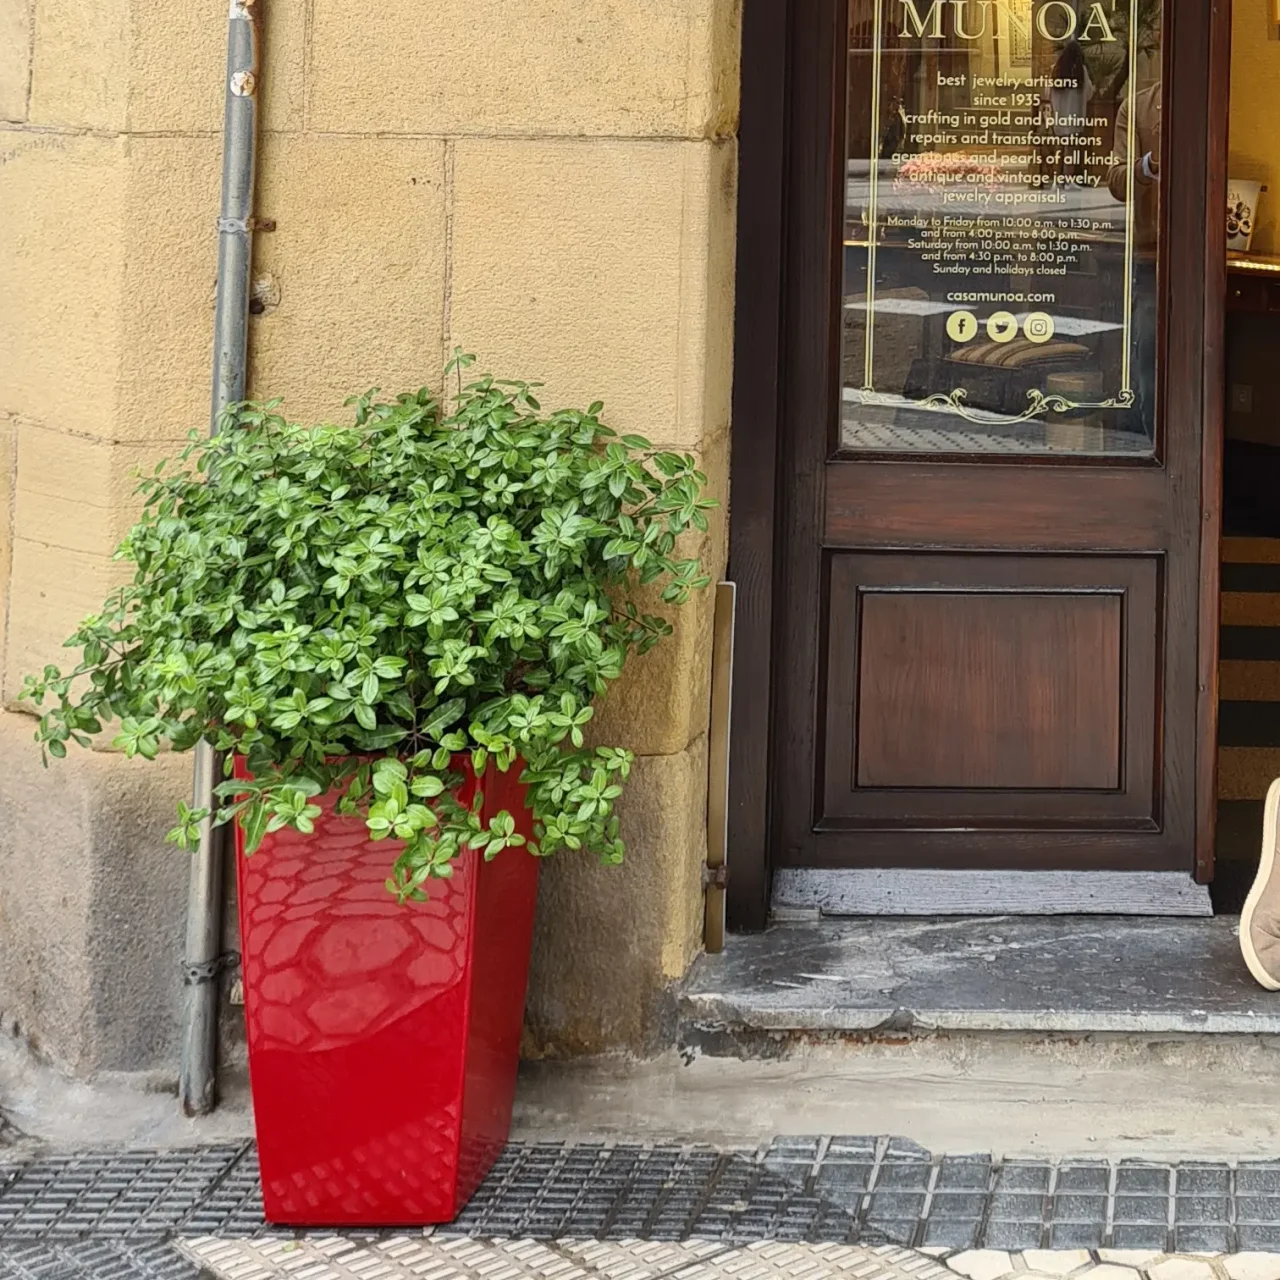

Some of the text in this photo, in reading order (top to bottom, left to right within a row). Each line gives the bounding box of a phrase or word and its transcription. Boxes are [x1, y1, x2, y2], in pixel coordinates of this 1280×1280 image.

[937, 71, 1078, 90] best jewelry artisans
[973, 93, 1040, 107] since 1935
[905, 111, 1108, 129] crafting in gold and platinum
[910, 131, 1102, 147] repairs and transformations
[969, 150, 997, 163] and
[1001, 150, 1042, 165] pearls
[1046, 150, 1060, 164] of
[1064, 151, 1080, 165] all
[1083, 151, 1120, 165] kinds
[910, 169, 1101, 187] antique and vintage jewelry
[942, 189, 1066, 204] jewelry appraisals
[887, 217, 929, 228] Monday
[931, 217, 941, 225] to
[944, 216, 974, 228] Friday
[976, 217, 1000, 226] from
[1003, 218, 1031, 227] 10:00
[1058, 219, 1068, 228] to
[1070, 219, 1090, 228] 1:30
[1092, 222, 1114, 231] p.m.
[921, 229, 939, 238] and
[943, 228, 966, 238] from
[968, 229, 993, 238] 4:00
[995, 231, 1016, 240] p.m.
[1019, 230, 1028, 238] to
[1058, 232, 1080, 241] p.m.
[908, 239, 952, 250] Saturday
[955, 240, 979, 250] from
[981, 240, 1010, 250] 10:00
[1036, 242, 1047, 250] to
[1050, 242, 1068, 251] 1:30
[1071, 244, 1092, 253] p.m.
[921, 251, 1078, 264] and from 4:30 p.m. to 8:00 p.m.
[933, 264, 1066, 275] Sunday and holidays closed
[947, 291, 1055, 303] casamunoa.com
